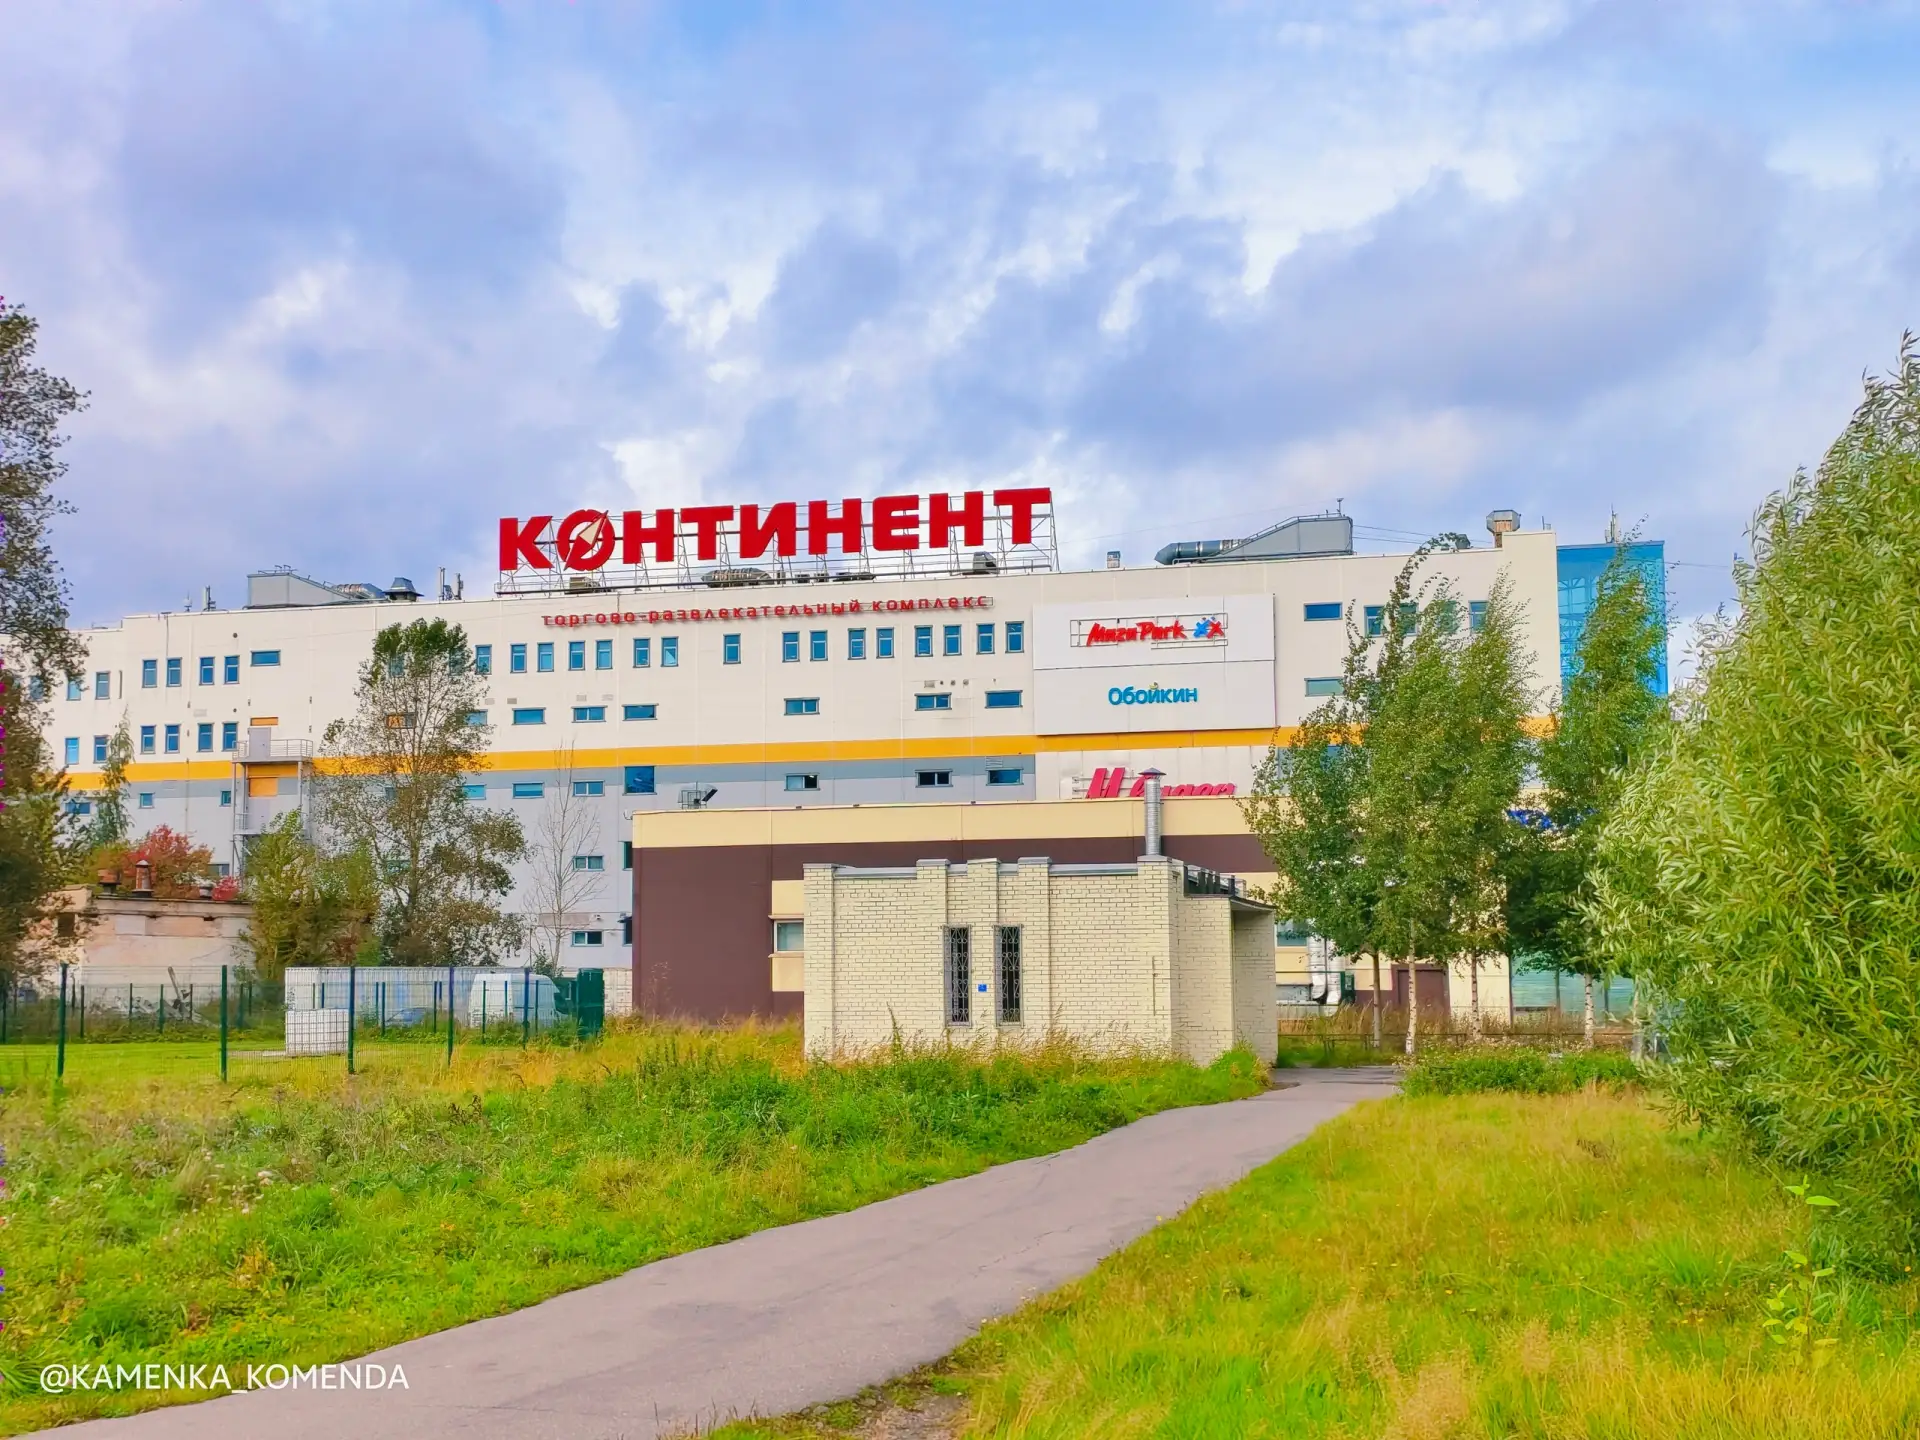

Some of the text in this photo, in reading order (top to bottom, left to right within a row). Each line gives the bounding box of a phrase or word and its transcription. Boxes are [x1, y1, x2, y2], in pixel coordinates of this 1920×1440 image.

[499, 487, 1052, 571] КОНТИНЕНТ
[541, 596, 988, 628] торгово-развлекательный комплекс
[1107, 682, 1199, 706] Обойкин
